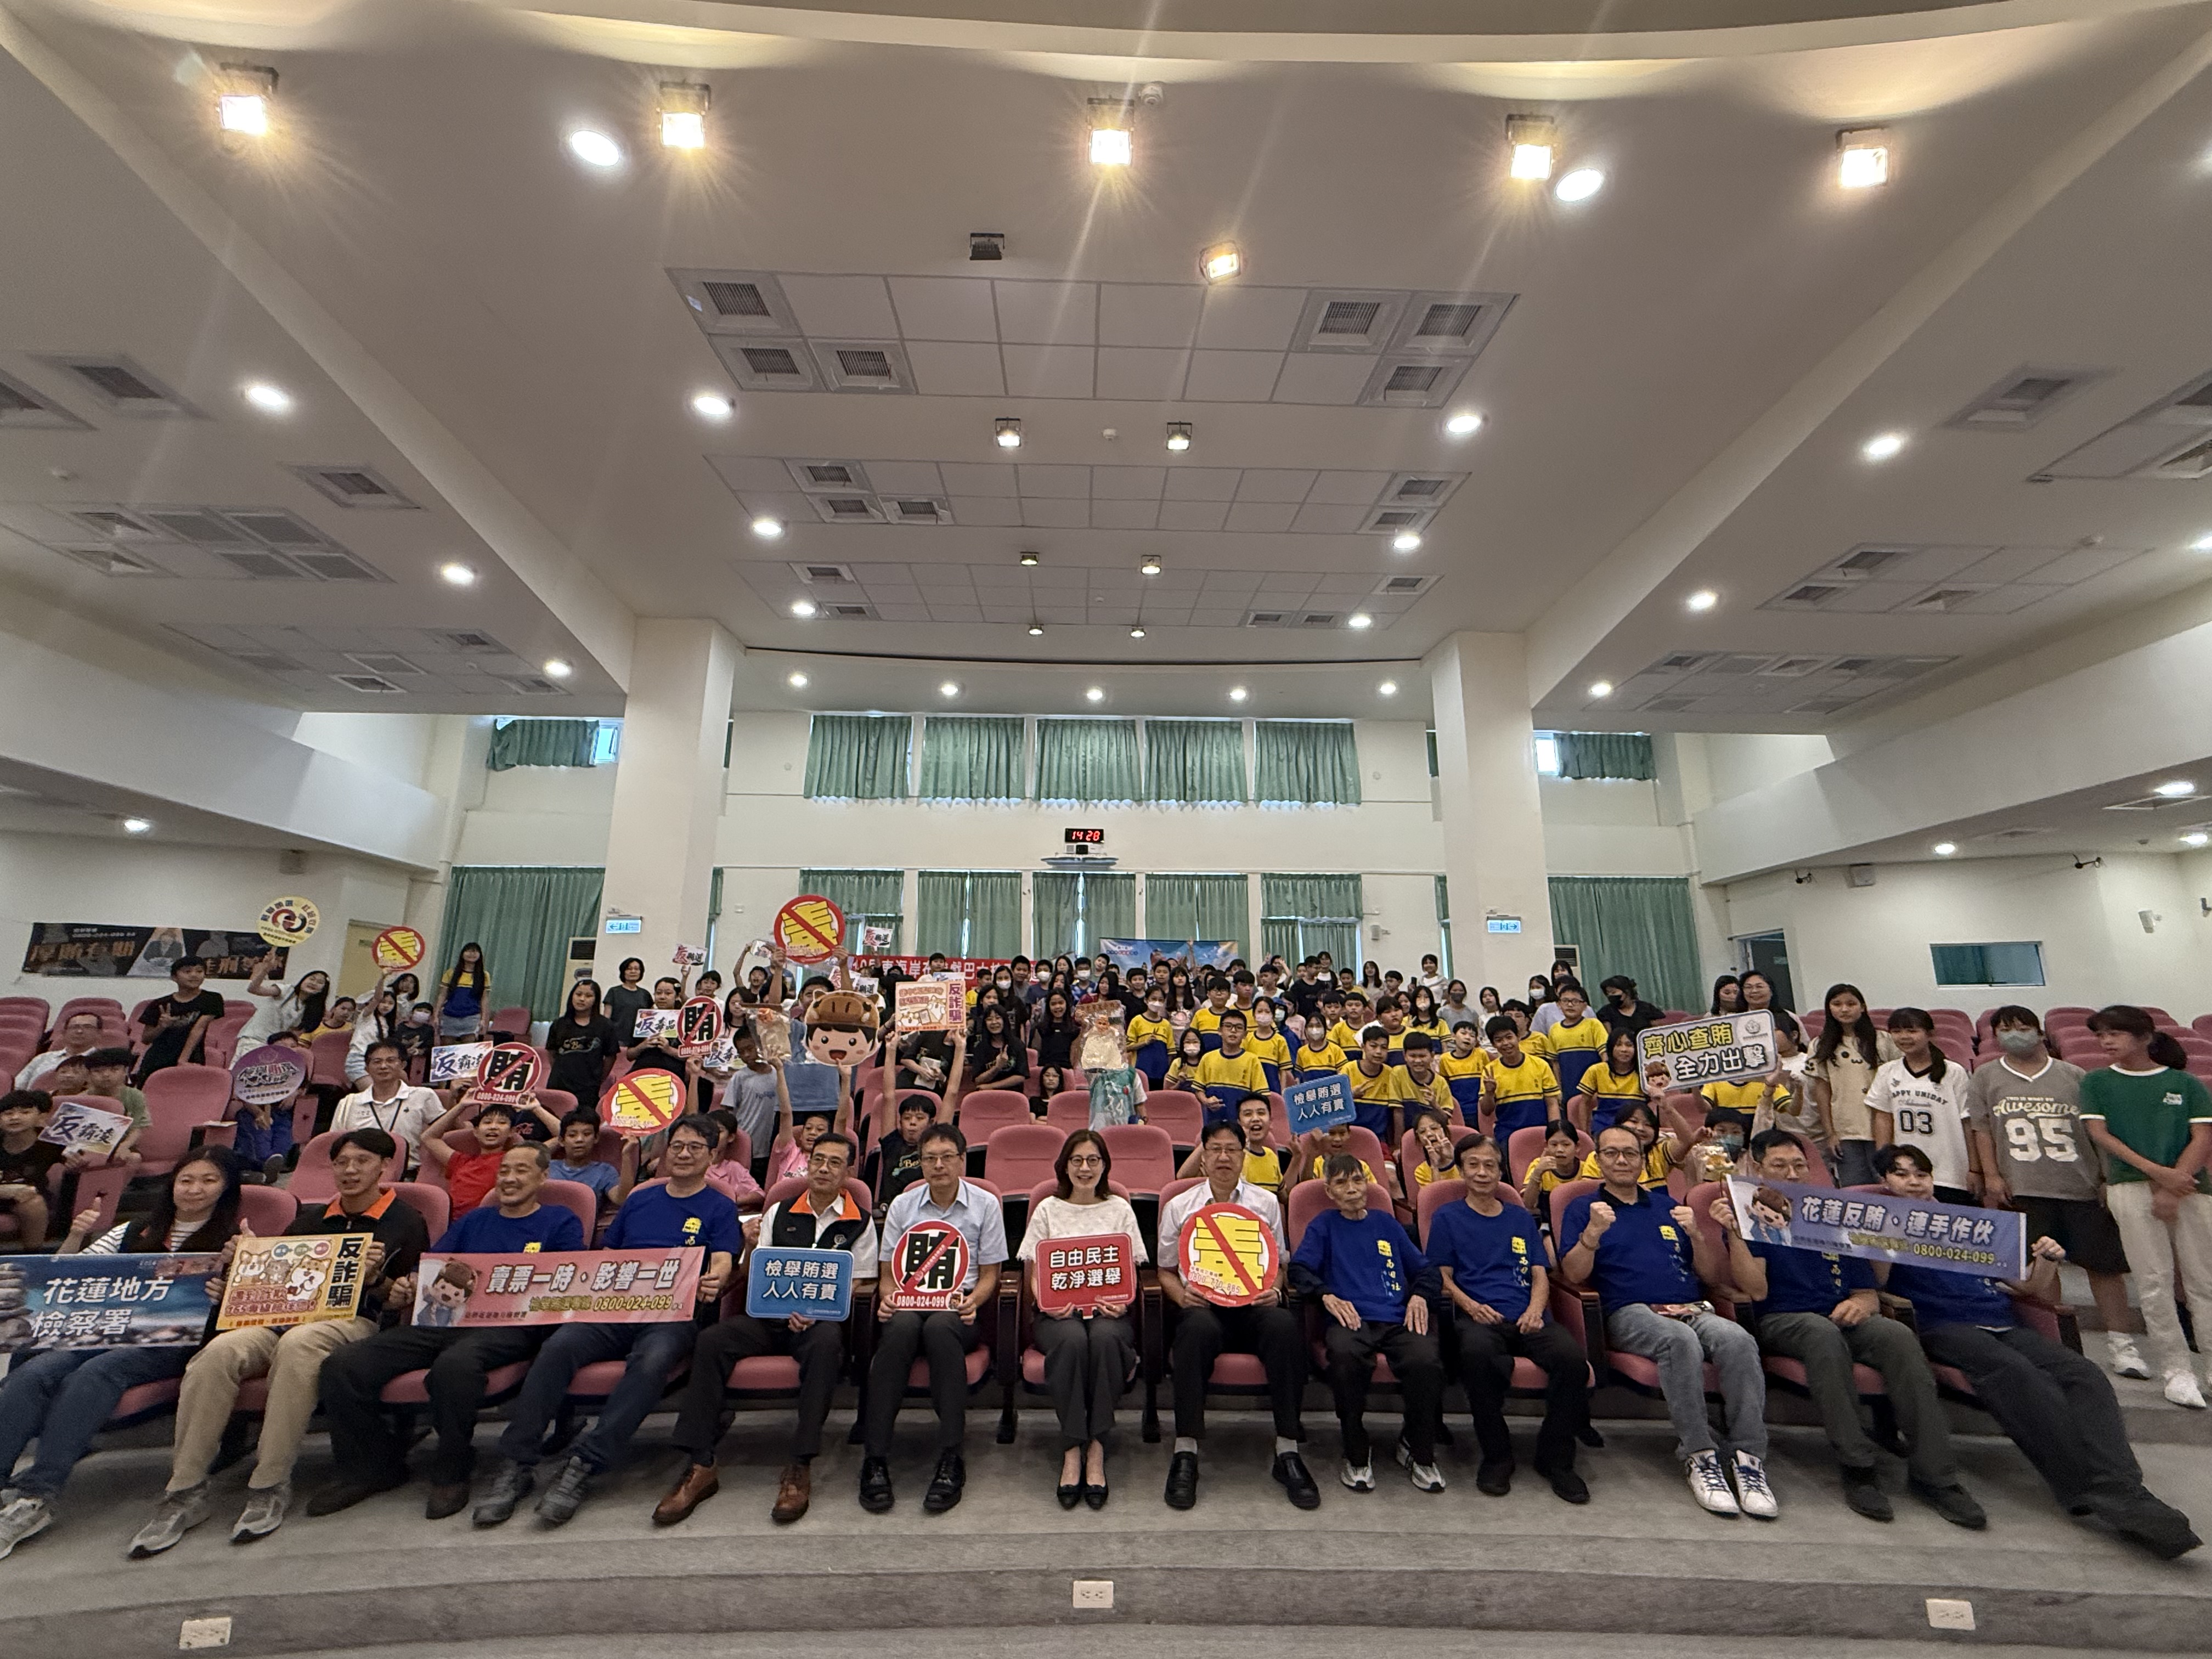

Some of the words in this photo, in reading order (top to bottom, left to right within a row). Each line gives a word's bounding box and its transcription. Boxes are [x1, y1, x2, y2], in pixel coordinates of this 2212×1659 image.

[949, 984, 962, 1021] 反詐騙
[1643, 1023, 1733, 1058] 齊心查賄
[1675, 1044, 1765, 1080] 全力出擊
[1294, 1082, 1342, 1106] 檢舉賄選
[1297, 1098, 1345, 1121] 人人有責
[1993, 1099, 2080, 1118] Awesome
[1899, 1109, 1933, 1135] 03
[2004, 1118, 2079, 1162] 95
[901, 1231, 960, 1290] 賄
[1049, 1245, 1120, 1268] 自由民主
[1913, 1243, 1995, 1265] 0800-024-099
[325, 1237, 364, 1308] 反詐騙
[764, 1259, 839, 1280] 檢舉賄選
[1051, 1267, 1121, 1290] 乾淨選舉
[43, 1276, 174, 1305] 花蓮地方
[761, 1281, 838, 1301] 人人有責
[896, 1295, 945, 1308] 0800-024-099
[593, 1294, 674, 1312] 0800-024-099
[32, 1308, 133, 1338] 檢察署
